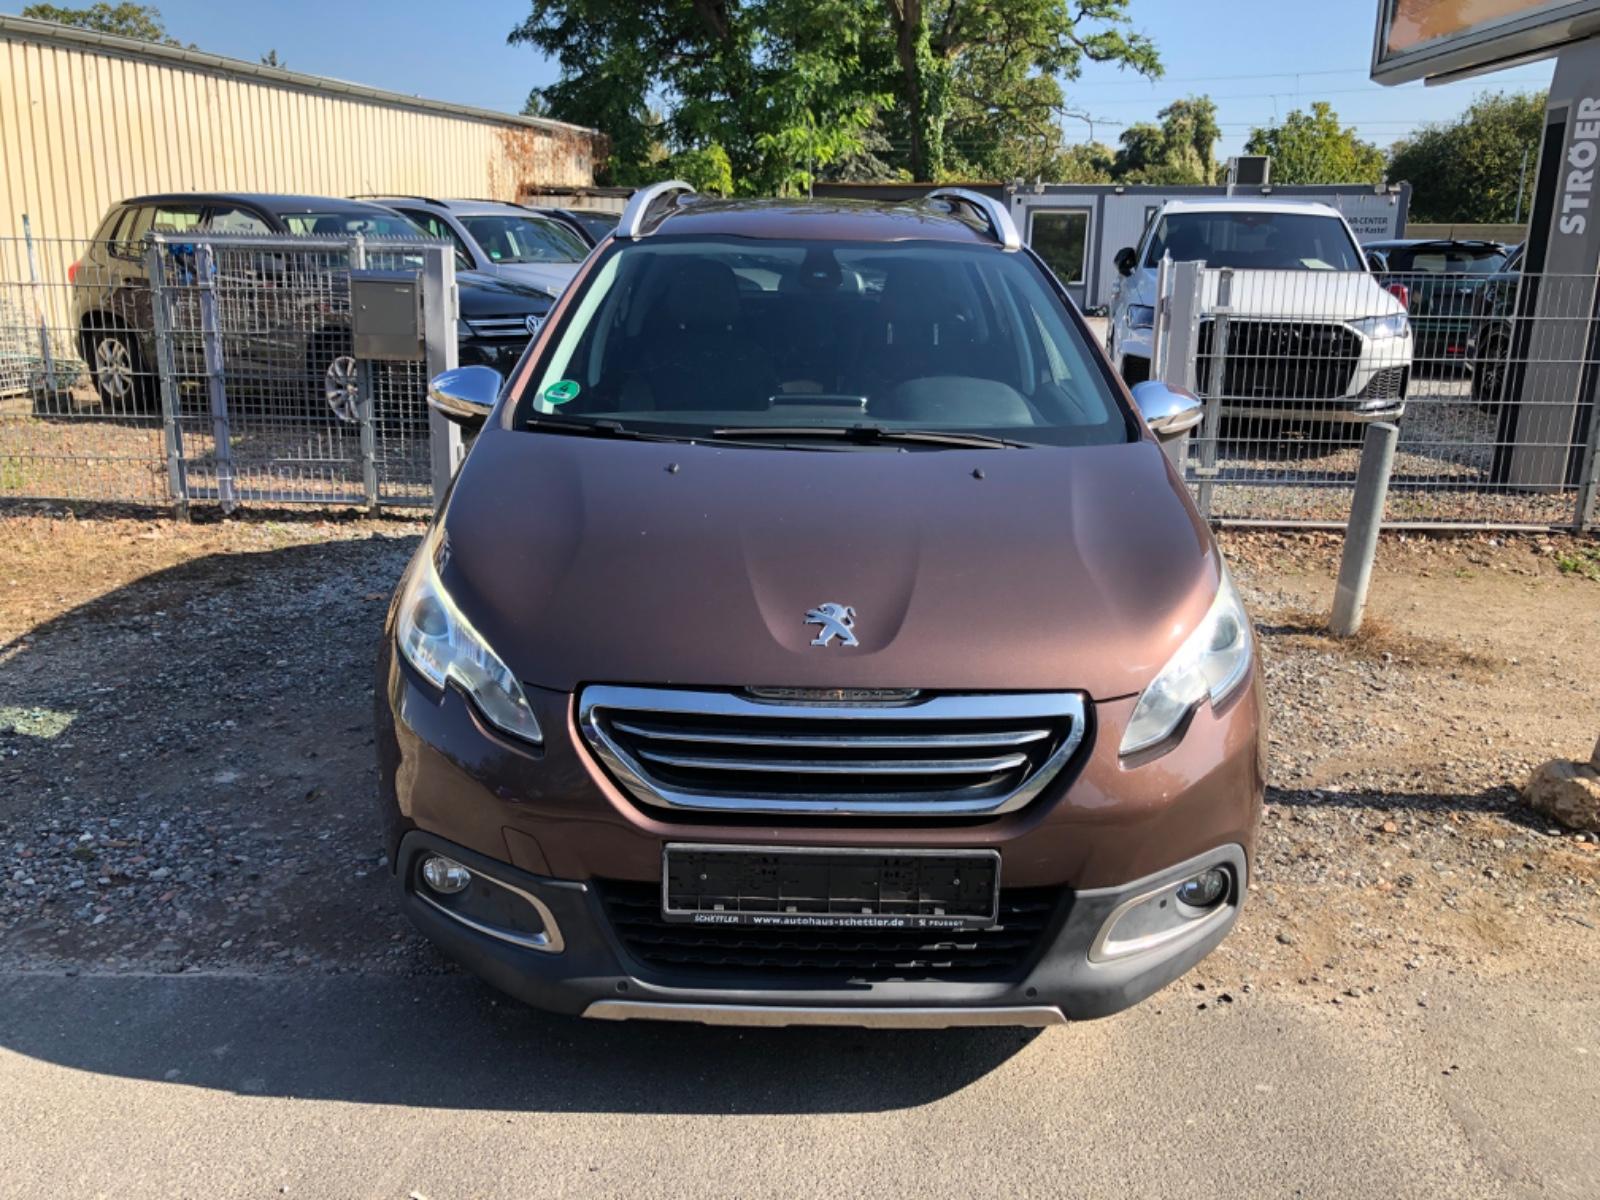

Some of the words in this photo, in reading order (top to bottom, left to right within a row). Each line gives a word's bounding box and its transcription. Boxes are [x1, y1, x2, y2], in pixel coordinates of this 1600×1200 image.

[1559, 97, 1600, 235] STRÖER
[1345, 216, 1388, 225] AR-CENTER
[694, 913, 739, 923] SCHETTLER
[753, 915, 904, 927] www.autohaus-schettler.de
